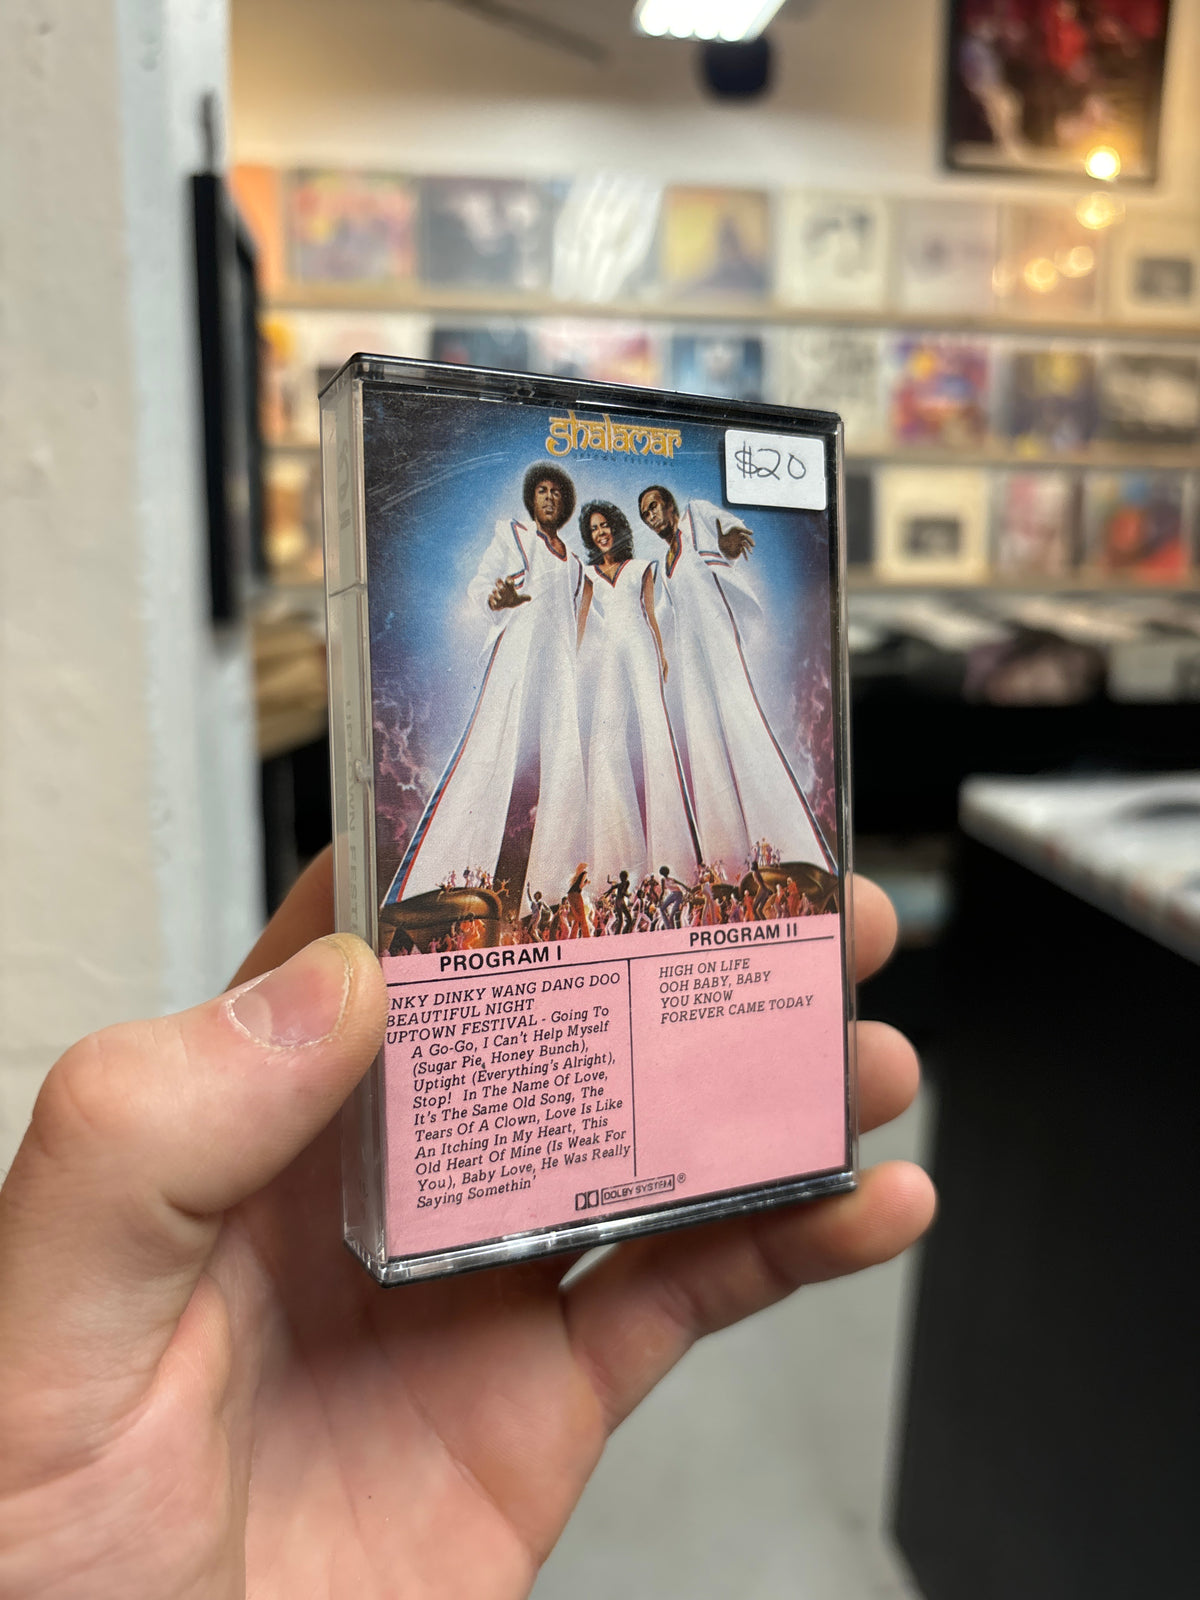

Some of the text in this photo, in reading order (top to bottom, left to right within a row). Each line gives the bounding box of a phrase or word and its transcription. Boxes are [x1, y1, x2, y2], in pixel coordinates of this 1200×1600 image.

[734, 440, 807, 480] $20
[690, 922, 798, 947] PROGRAM II
[440, 945, 561, 972] PROGRAM I
[659, 958, 750, 978] HIGH ON LIFE
[391, 972, 620, 1010] NKY DINKY WANG DANG DOO
[659, 970, 771, 994] OOH BABY, BABY
[661, 990, 733, 1009] YOU KNOW
[386, 998, 535, 1027] BEAUTIFUL NIGHT
[387, 1024, 457, 1044] UPTOWN
[461, 1014, 538, 1036] FESTIVAL
[551, 1009, 588, 1023] Going
[593, 1005, 609, 1018] To
[660, 995, 813, 1024] FOREVER CAME TODAY
[410, 1020, 610, 1059] A Go-Go, I Can't Help Myself
[413, 1039, 588, 1078] (Sugar Pie, Honey Bunch),
[413, 1071, 608, 1109] Stop! In The Name Of Love,
[414, 1051, 615, 1094] Uptight (Everything's Alright),
[414, 1085, 604, 1126] It's The Same Old Song, The
[415, 1098, 623, 1142] Tears Of A Clown, Love Is Like
[414, 1115, 608, 1160] An Itching In My Heart, This
[415, 1129, 627, 1175] Old Heart Of Mine (Is Weak For
[417, 1144, 631, 1192] You), Baby Love, He Was Really
[417, 1174, 536, 1209] Saying Somethin'
[603, 1188, 633, 1200] DOLBY
